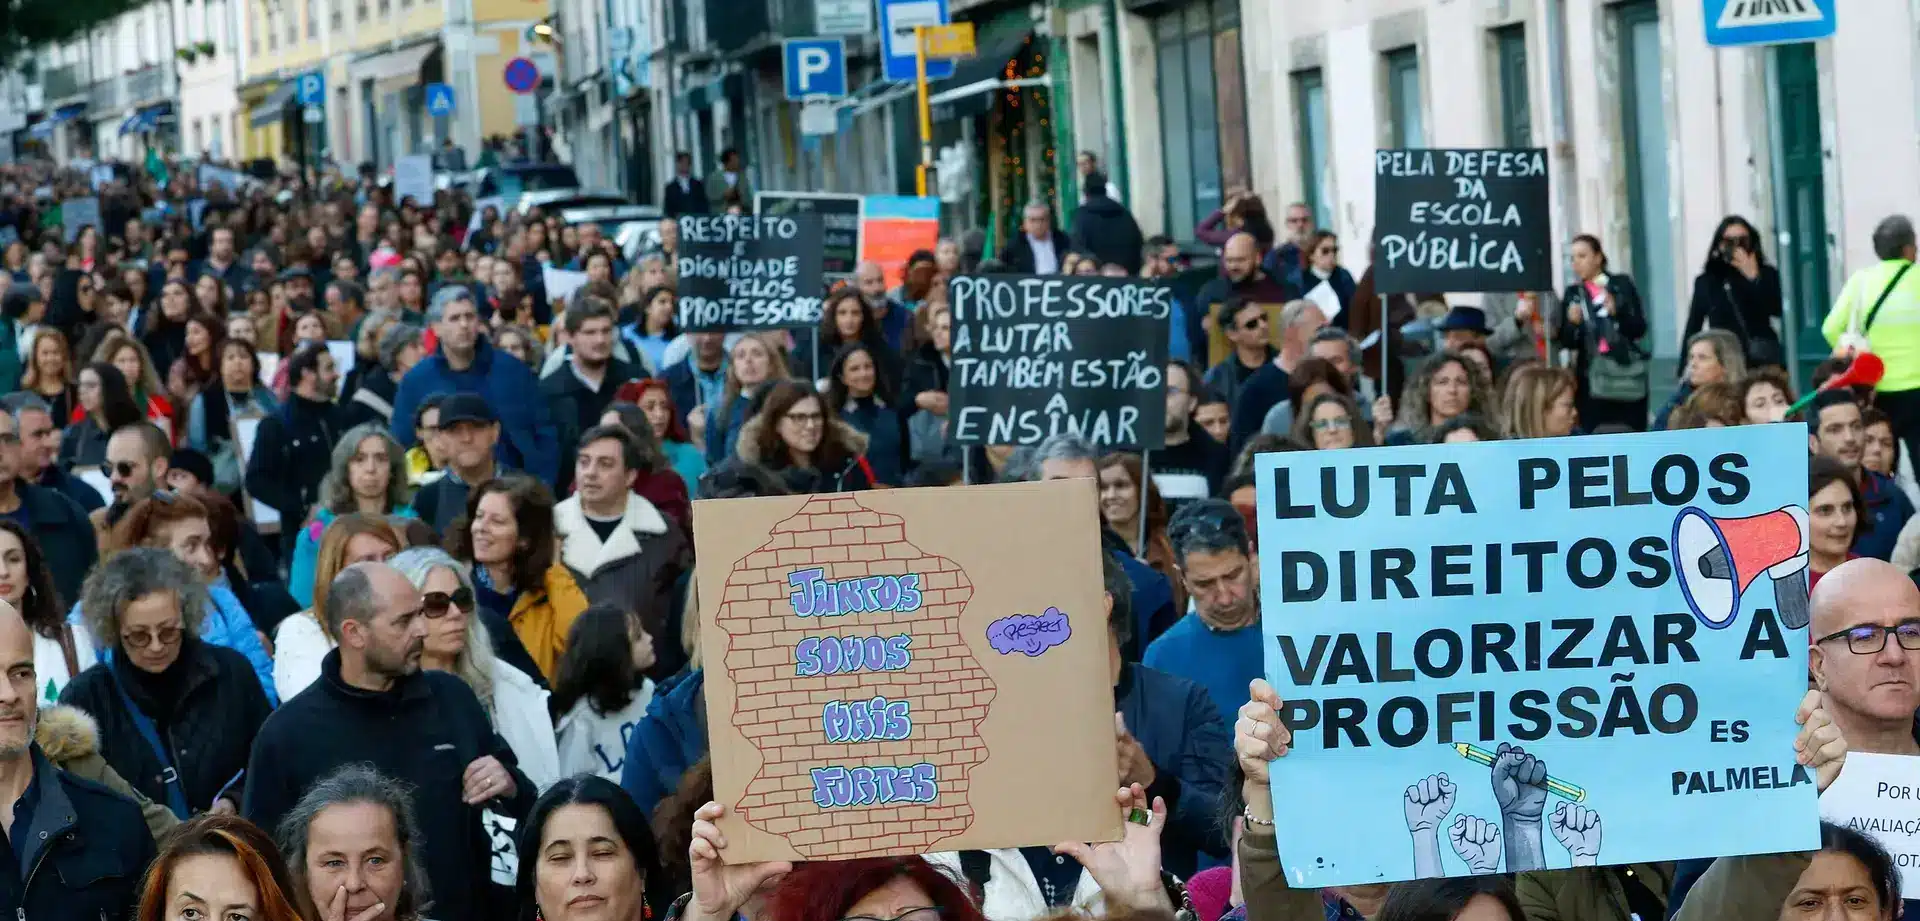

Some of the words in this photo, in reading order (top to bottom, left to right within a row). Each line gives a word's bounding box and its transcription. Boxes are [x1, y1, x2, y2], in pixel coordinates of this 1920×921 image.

[797, 47, 831, 91] P
[1376, 151, 1435, 177] PELA
[1444, 150, 1546, 178] DEFESA
[1453, 177, 1488, 201] DA
[679, 214, 798, 243] RESPEITO
[1409, 200, 1523, 227] ESCOLA
[726, 277, 797, 299] PELOS
[951, 275, 1172, 320] PROFESSORES
[679, 295, 824, 329] PROFESSORES
[952, 323, 973, 355] A
[979, 321, 1073, 353] LUTAR
[954, 352, 1065, 390] TAMBÉM
[1070, 348, 1162, 390] ESTÃO
[1043, 392, 1069, 415] A
[1274, 462, 1478, 519] LUTA
[1518, 452, 1751, 510] PELOS
[1281, 536, 1672, 603] DIREITOS
[795, 633, 913, 676] SOMOS
[1276, 612, 1700, 686] VALORIZAR
[1739, 608, 1789, 660] A
[1279, 672, 1699, 749] PROFISSÃO
[1710, 720, 1750, 743] ES
[810, 763, 938, 808] FORTES
[1671, 763, 1813, 796] PALMELA
